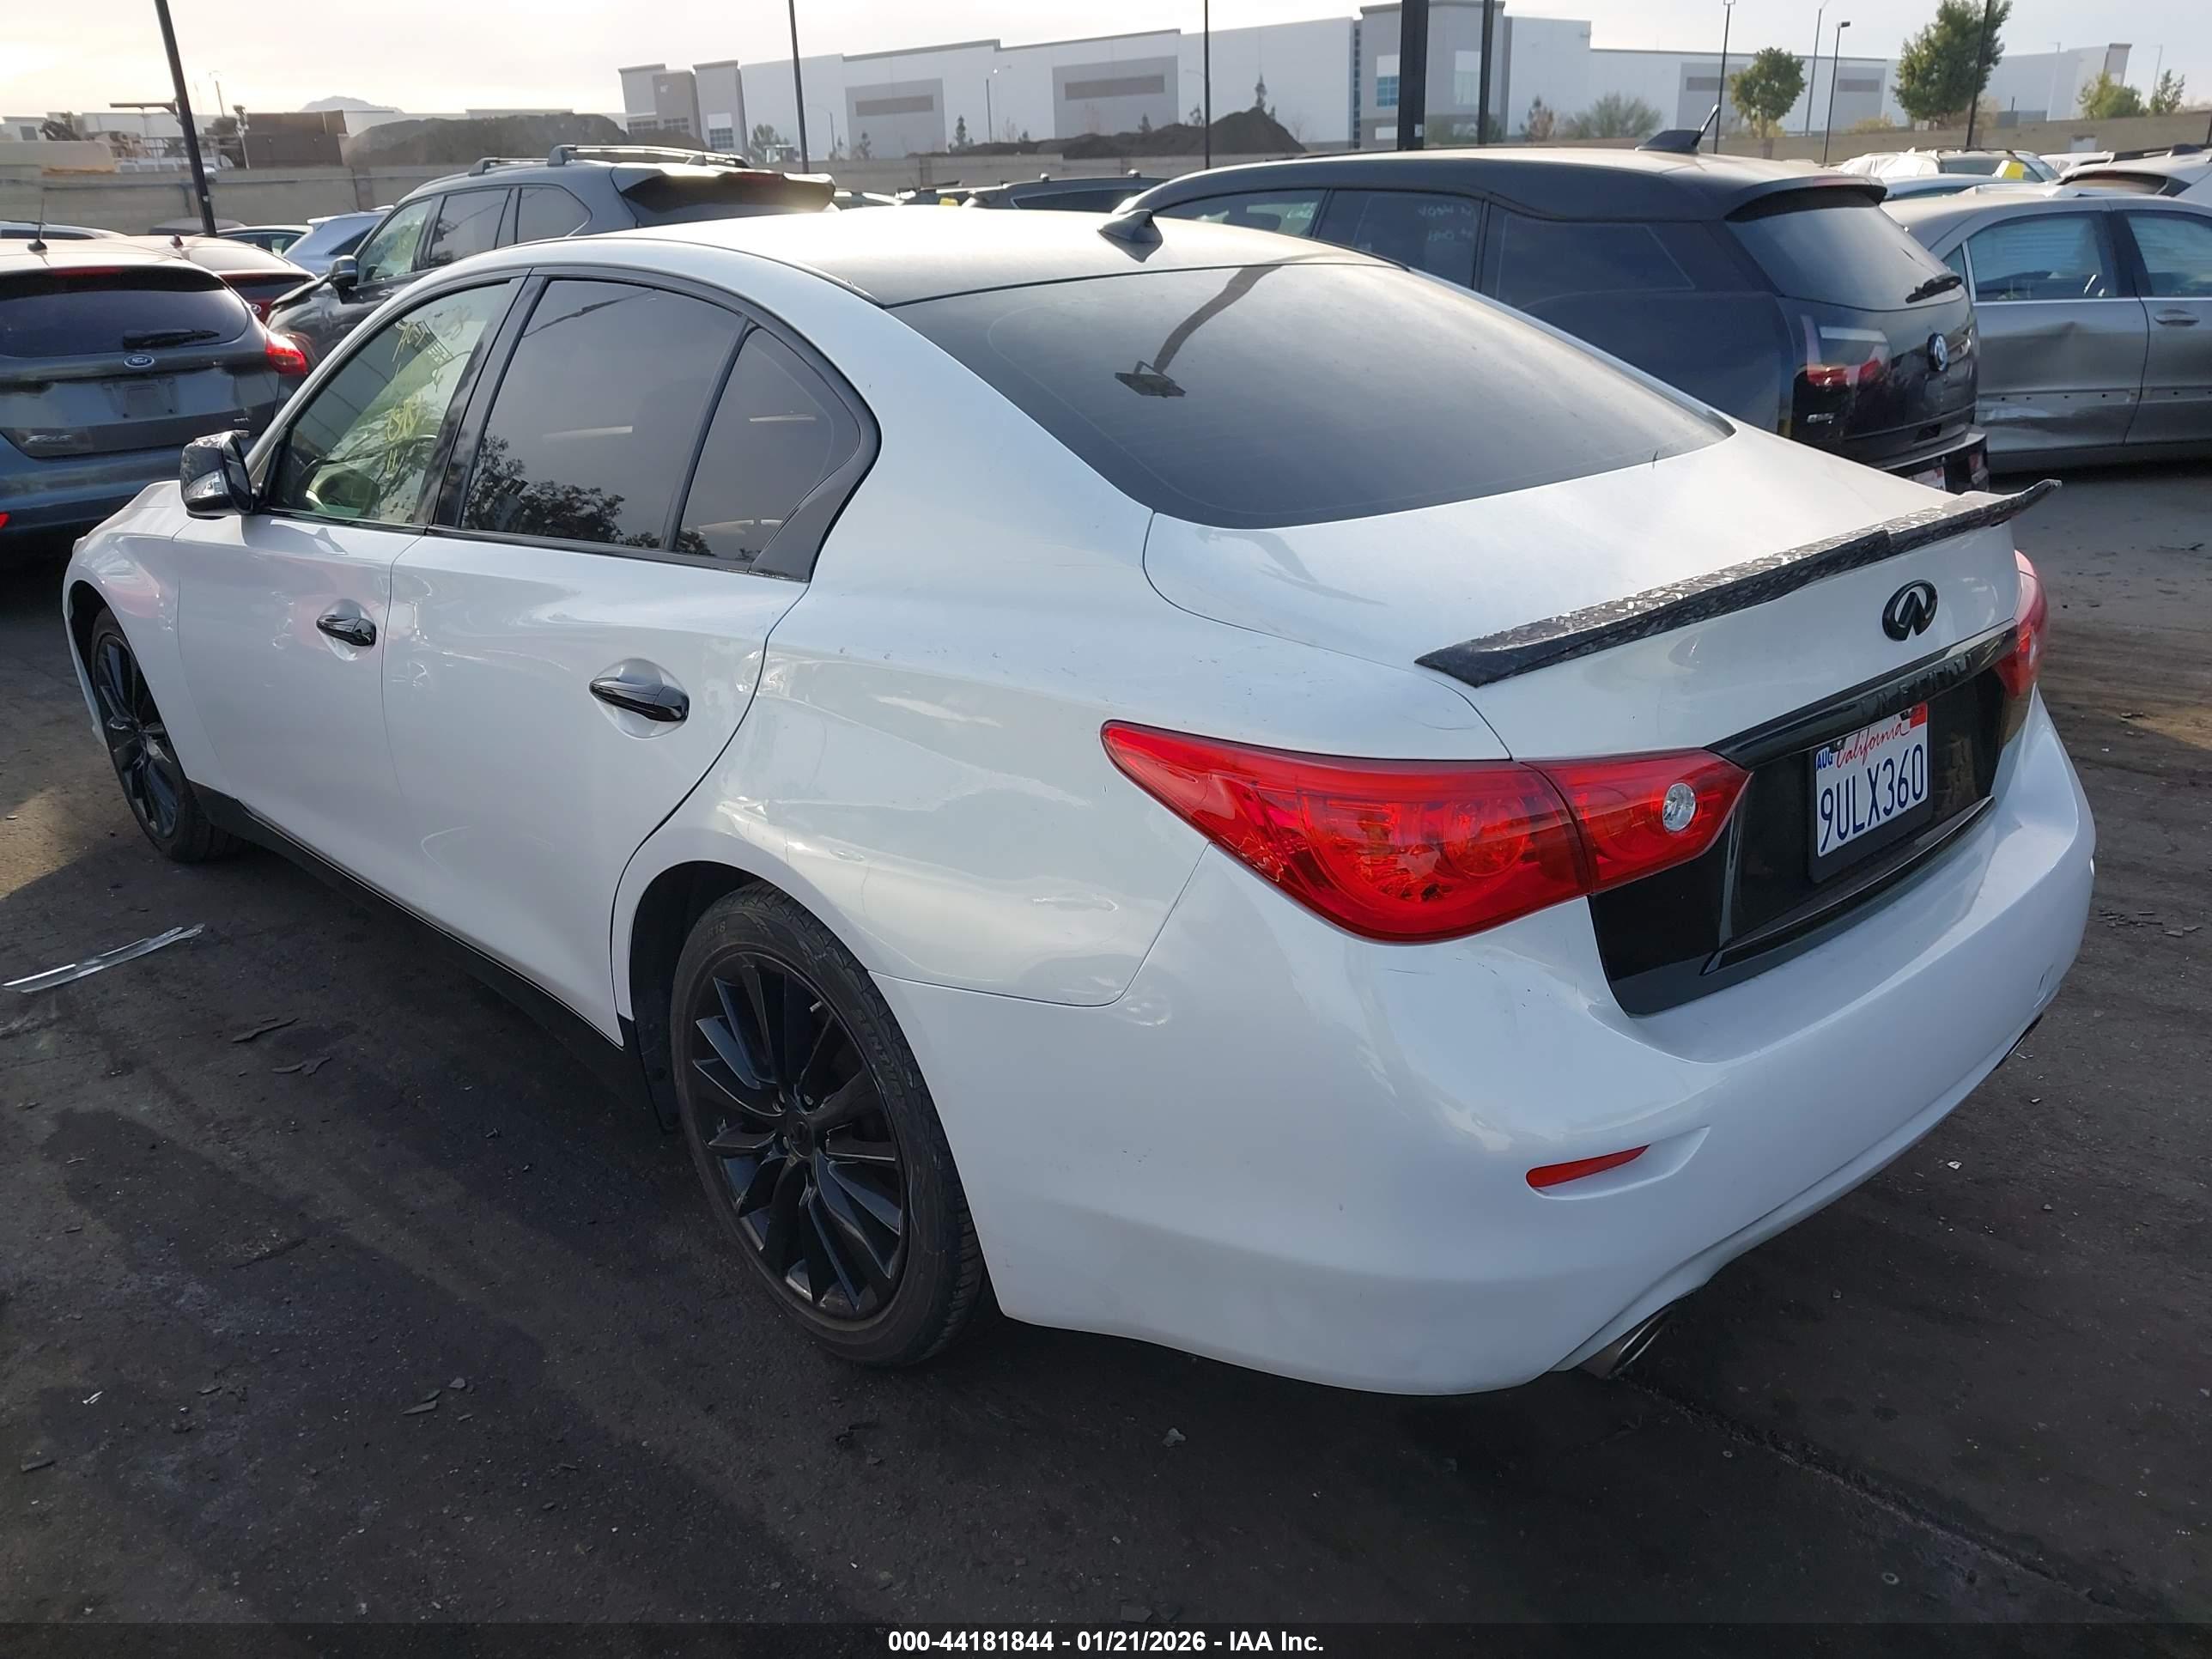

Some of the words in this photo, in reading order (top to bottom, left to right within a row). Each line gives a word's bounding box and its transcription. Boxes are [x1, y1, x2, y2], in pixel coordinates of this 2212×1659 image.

[1816, 749, 1833, 771] AUG
[1836, 717, 1911, 769] California
[1820, 744, 1924, 852] 9ULX360
